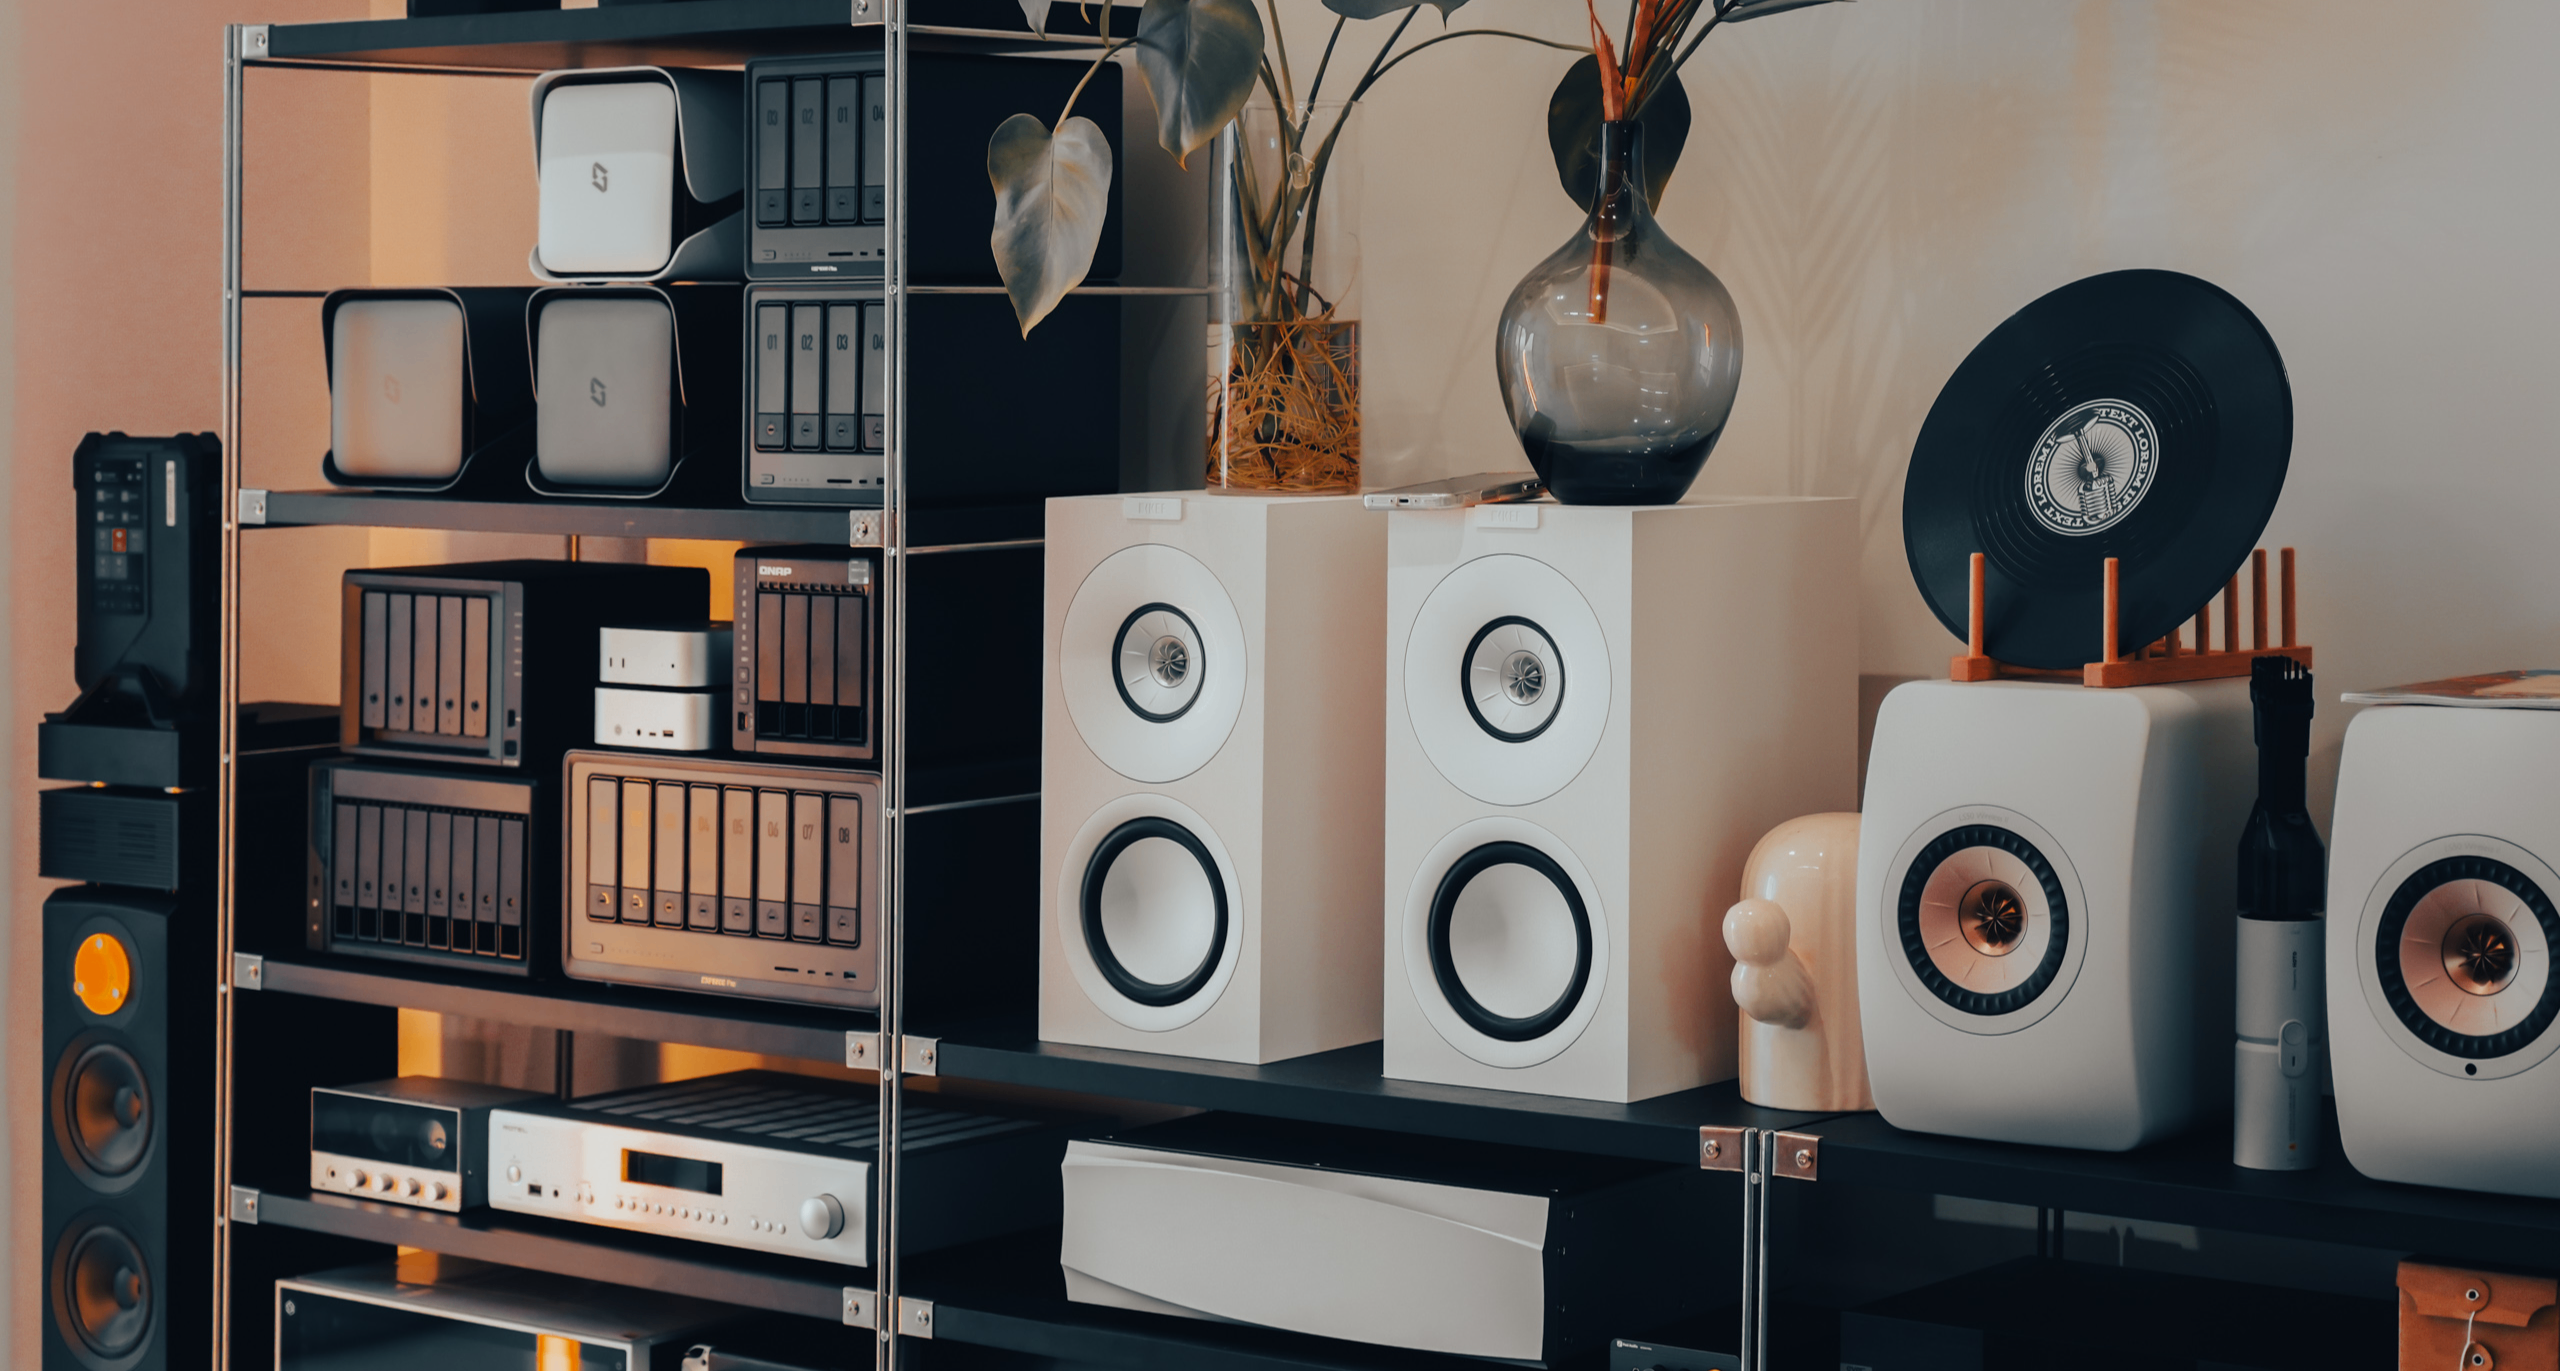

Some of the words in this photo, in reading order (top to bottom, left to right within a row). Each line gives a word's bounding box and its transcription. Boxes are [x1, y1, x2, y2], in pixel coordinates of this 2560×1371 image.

[767, 109, 778, 126] 03
[802, 108, 814, 124] 02
[837, 106, 848, 123] 01
[767, 334, 777, 350] 01
[801, 334, 813, 351] 02
[837, 334, 848, 350] 03
[2099, 408, 2138, 428] TEXT
[2133, 428, 2149, 488] LOREM
[2034, 446, 2051, 506] LOREM
[2044, 505, 2084, 527] TEXT
[759, 565, 792, 576] QNAP
[732, 818, 744, 835] 05
[767, 821, 779, 838] 06
[802, 824, 814, 840] 07
[838, 827, 850, 844] 08
